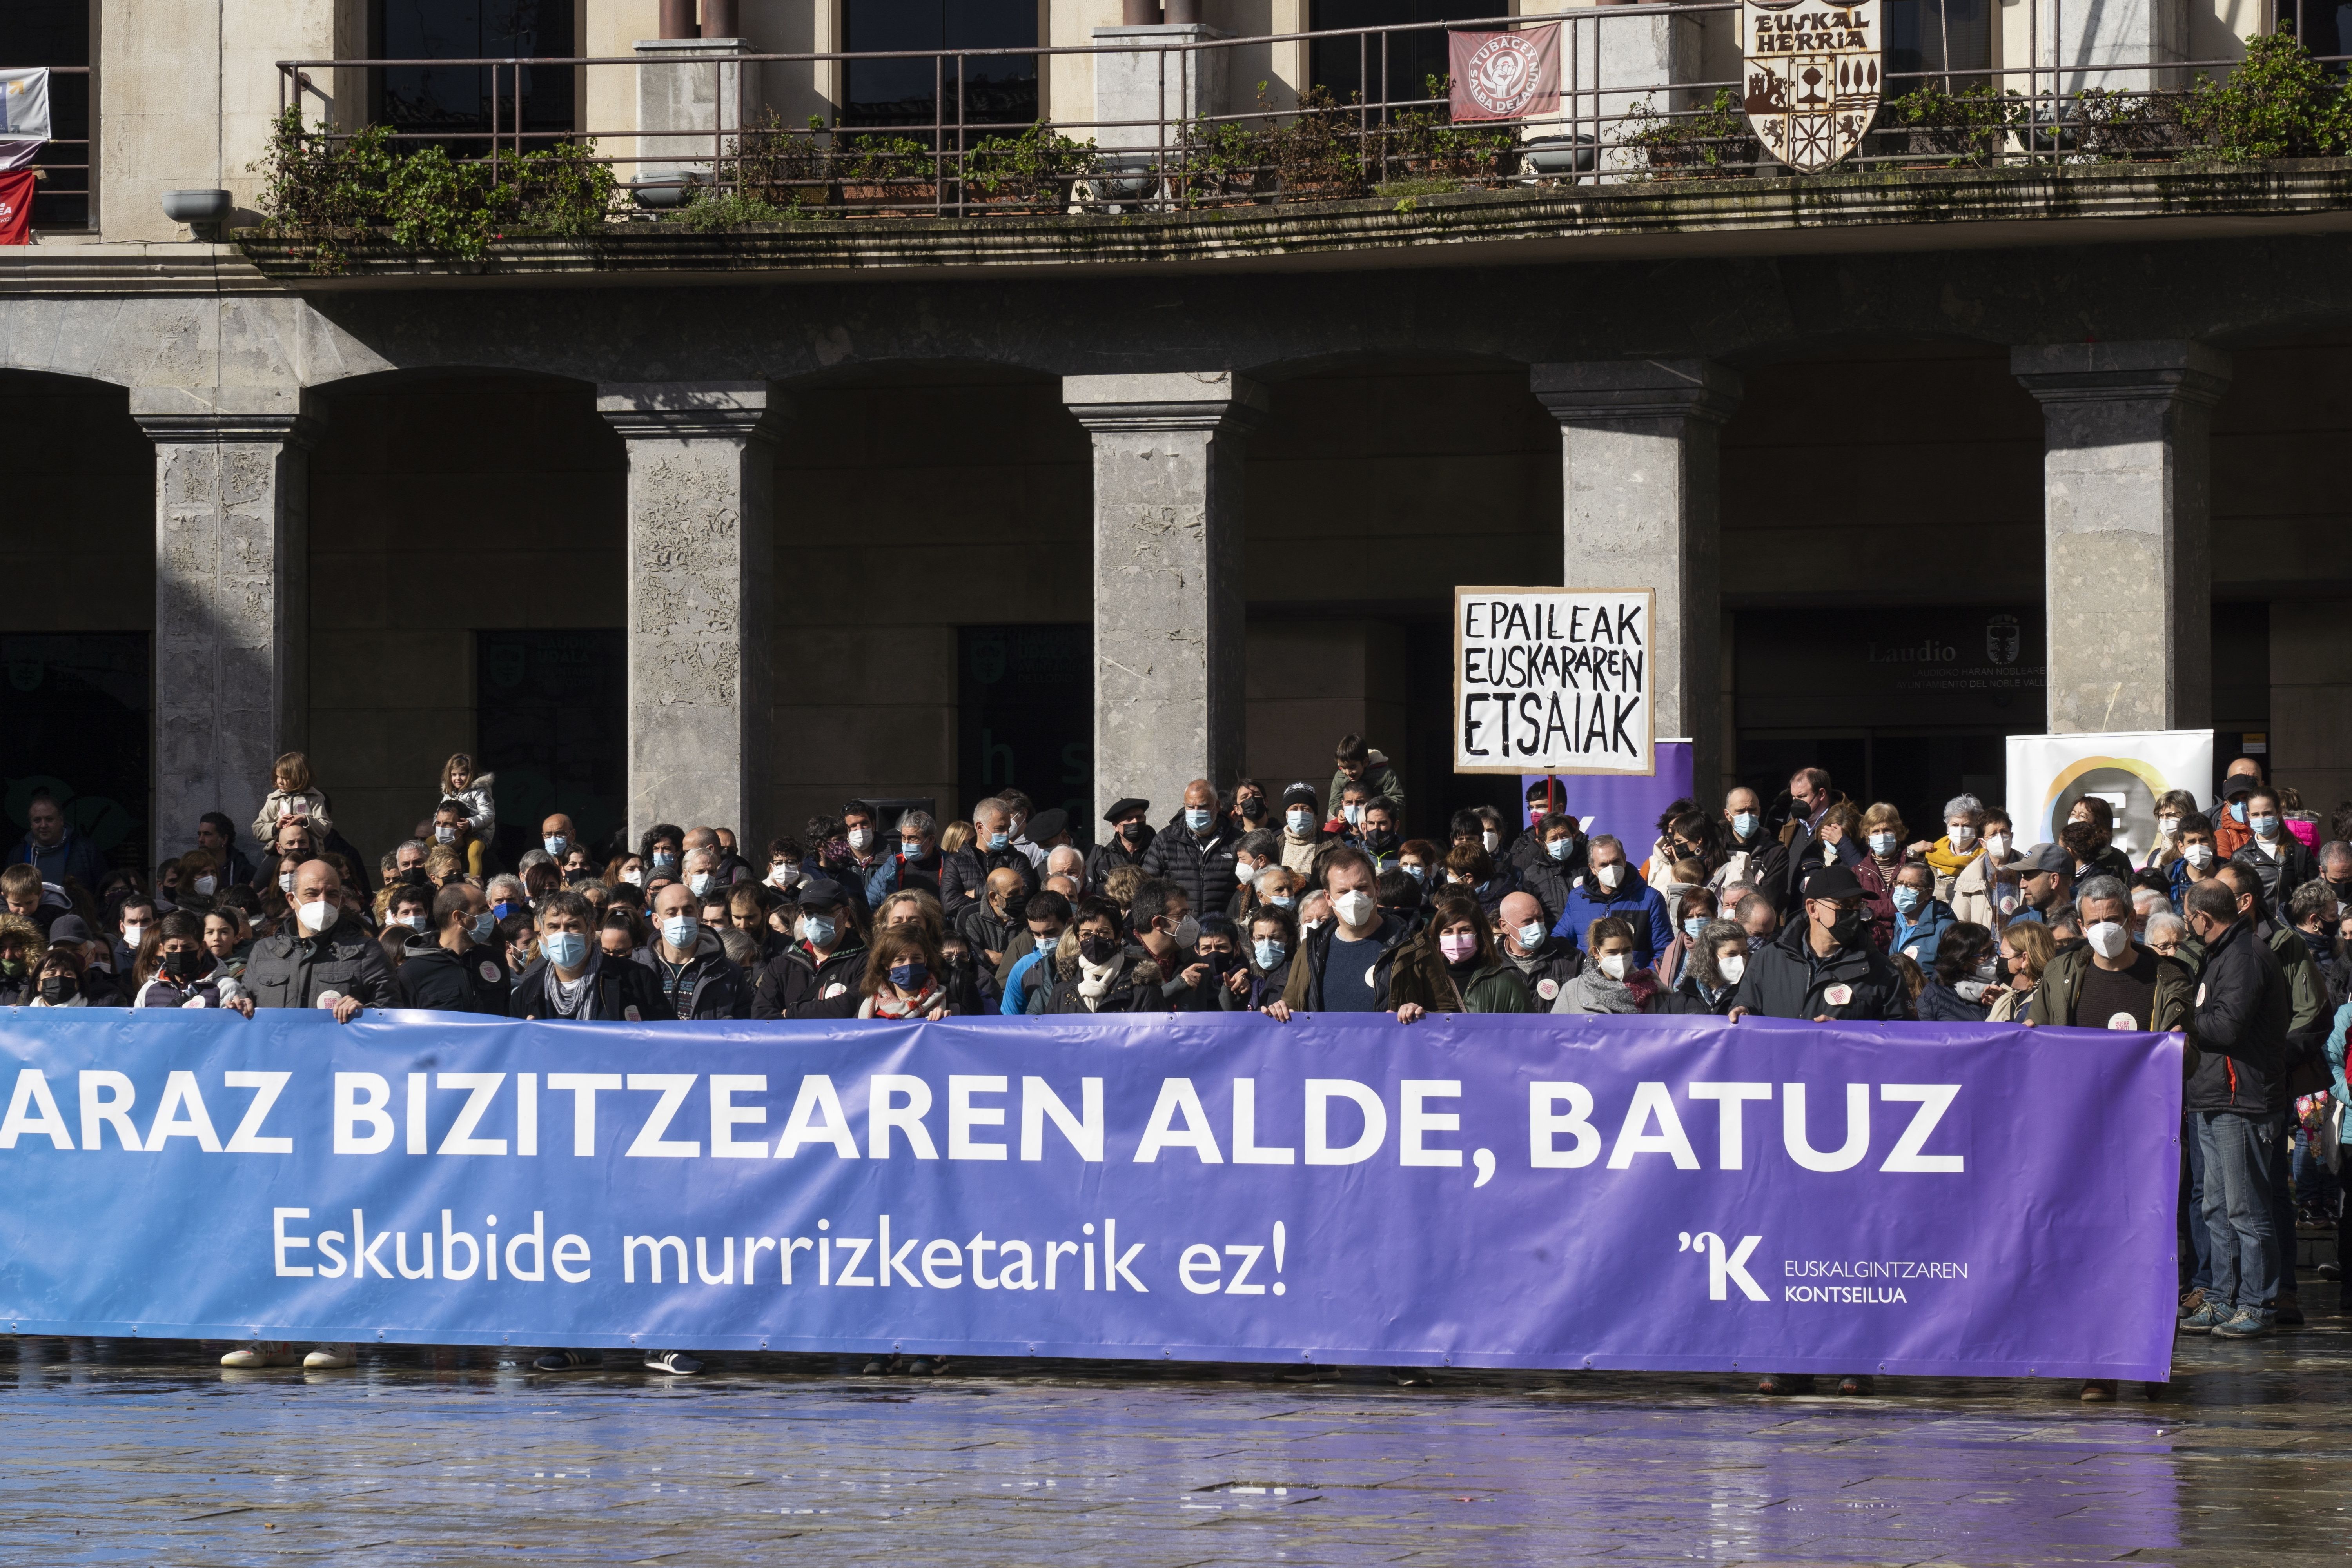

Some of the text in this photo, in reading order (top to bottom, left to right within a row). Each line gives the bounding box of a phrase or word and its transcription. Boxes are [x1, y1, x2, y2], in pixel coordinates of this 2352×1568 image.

[1755, 11, 1870, 32] EUSKAL
[1472, 38, 1536, 65] TUBACEX
[1470, 62, 1539, 111] SALBA DEZAGUN
[1466, 601, 1642, 646] EPAILEAK
[1867, 639, 1956, 662] Laudio
[1465, 642, 1643, 693] EUSKARAREN
[1913, 668, 1959, 677] LAUDIOKO
[1962, 668, 1994, 676] HARAN
[1896, 680, 1967, 689] AYUNTAMIENTO
[1990, 679, 2020, 688] NOBLE
[2023, 679, 2046, 687] VALL
[1465, 691, 1640, 757] ETSAIAK
[0, 1069, 1964, 1188] ARAZ BIZITZEAREN ALDE, BATUZ
[273, 1207, 1286, 1296] Eskubide murrizketarik ez!
[1785, 1260, 1967, 1279] EUSKALGINTZAREN
[1785, 1286, 1907, 1303] KONTSEILUA
